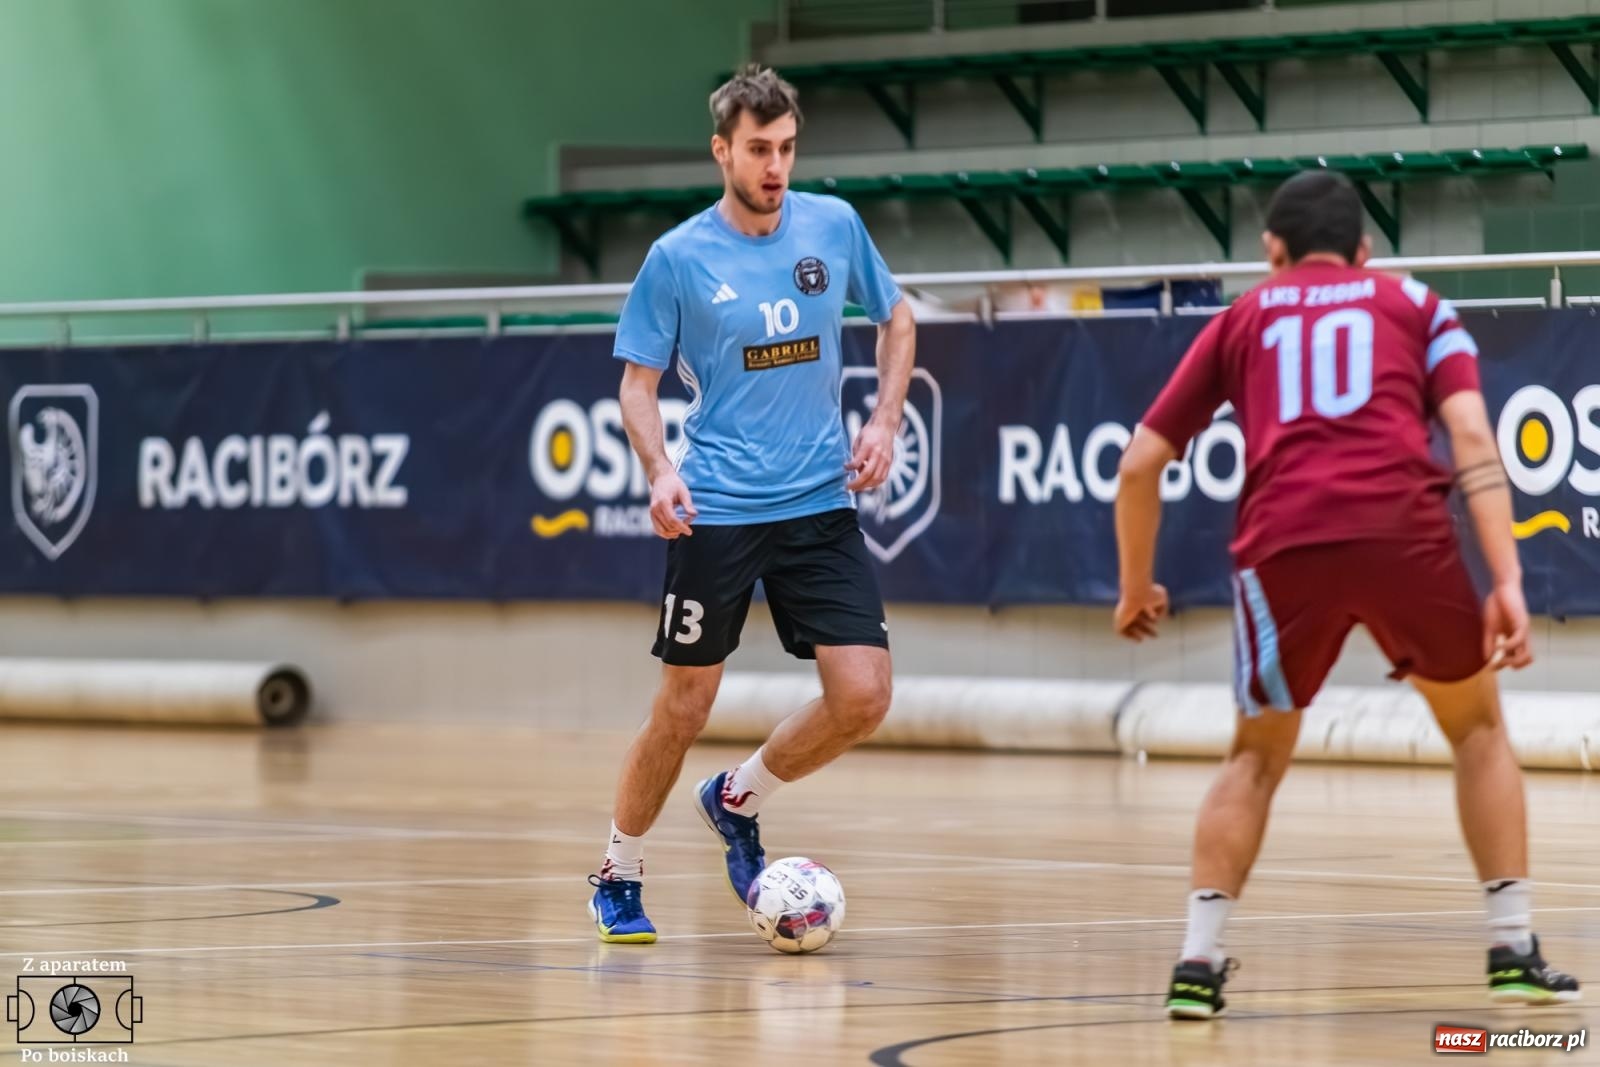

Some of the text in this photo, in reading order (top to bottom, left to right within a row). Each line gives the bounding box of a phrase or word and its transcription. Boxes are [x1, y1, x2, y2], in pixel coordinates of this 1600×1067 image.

[746, 339, 819, 361] GABRIEL
[758, 298, 799, 338] 10
[1262, 308, 1374, 424] 10
[138, 410, 410, 509] RACIBÓRZ
[998, 400, 1246, 503] RACBÓ
[664, 593, 704, 645] 13
